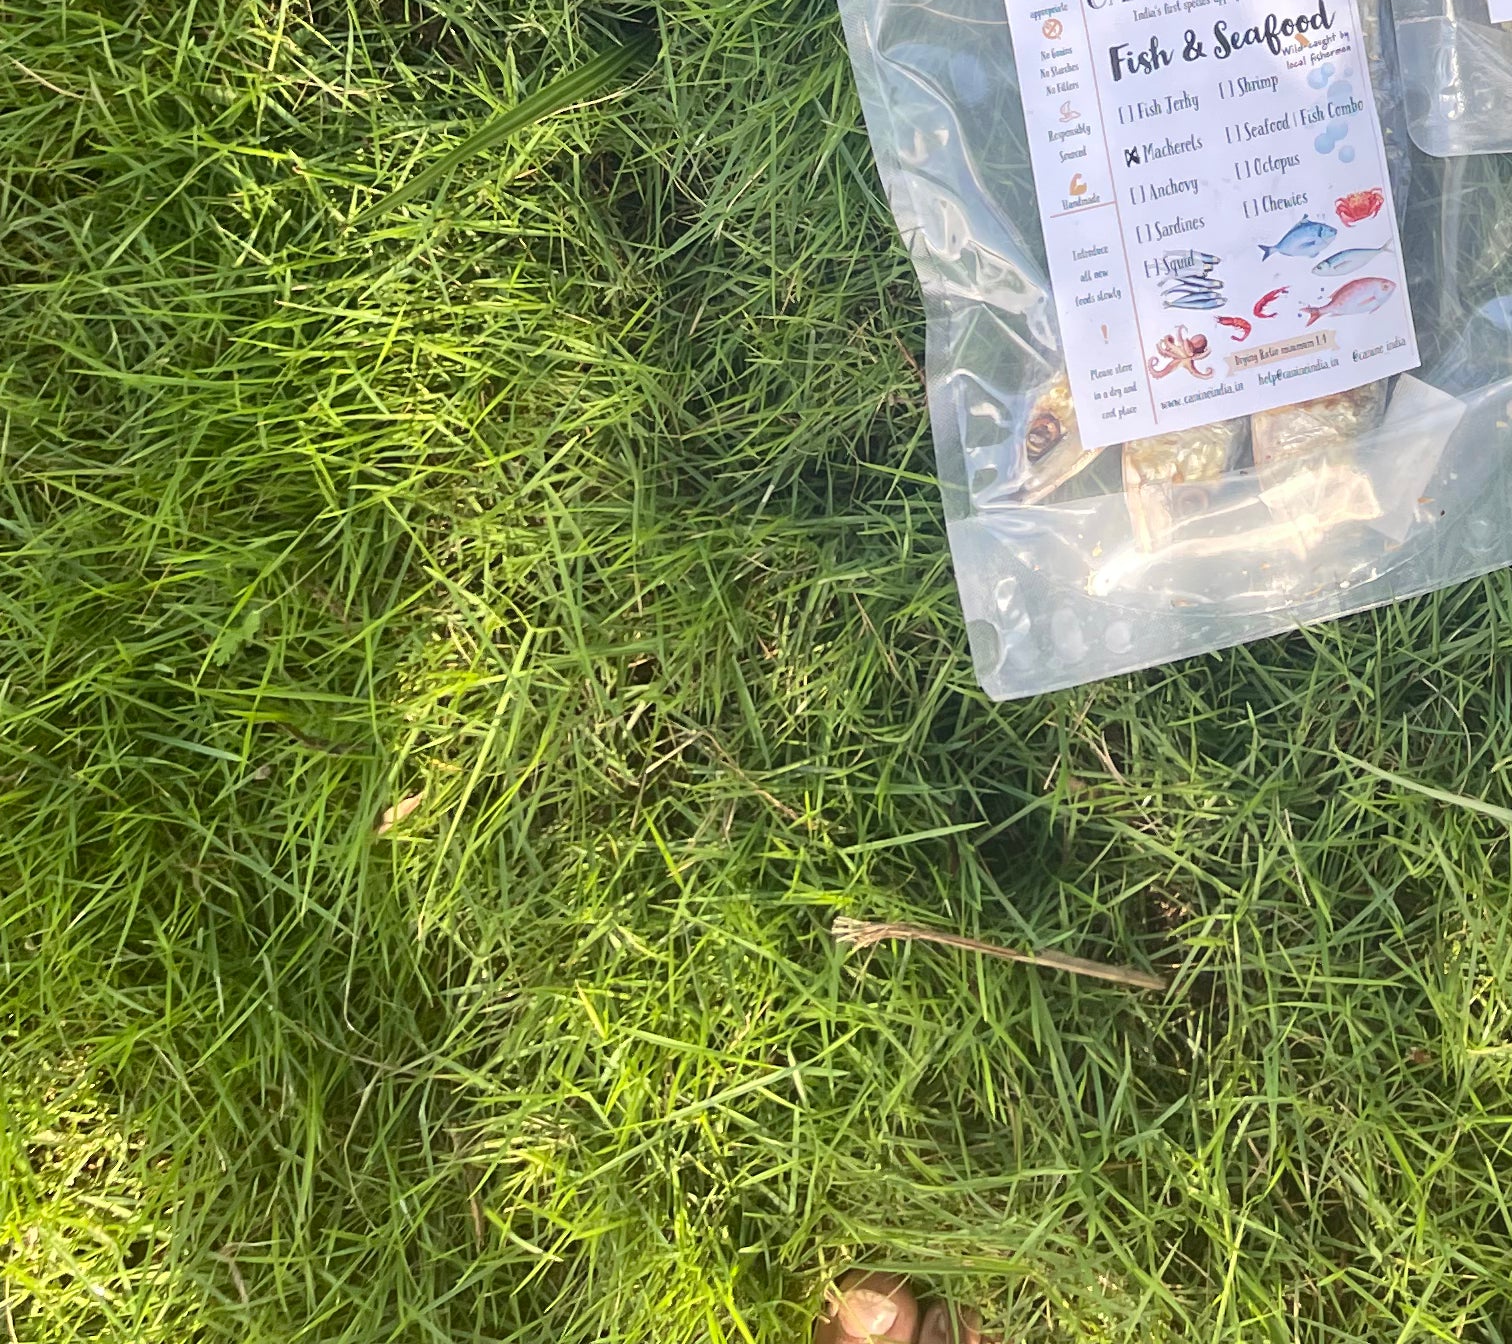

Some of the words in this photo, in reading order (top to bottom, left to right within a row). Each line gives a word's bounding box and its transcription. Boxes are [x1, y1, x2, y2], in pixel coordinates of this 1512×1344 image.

[1133, 5, 1162, 22] India's
[1163, 0, 1182, 15] first
[1108, 35, 1175, 83] Fish
[1182, 28, 1208, 63] &
[1286, 55, 1307, 70] local
[1238, 75, 1279, 97] Shrimp
[1137, 98, 1162, 119] Fish
[1164, 90, 1200, 115] Jerky
[1244, 112, 1291, 142] Seafood
[1300, 105, 1325, 126] Fish
[1327, 96, 1364, 119] Combo
[1142, 133, 1203, 164] Mackerels
[1254, 153, 1301, 176] Octopus
[1149, 177, 1199, 201] Anchovy
[1262, 192, 1309, 214] Chewies
[1154, 215, 1205, 241] Sardines
[1163, 249, 1196, 277] Squid
